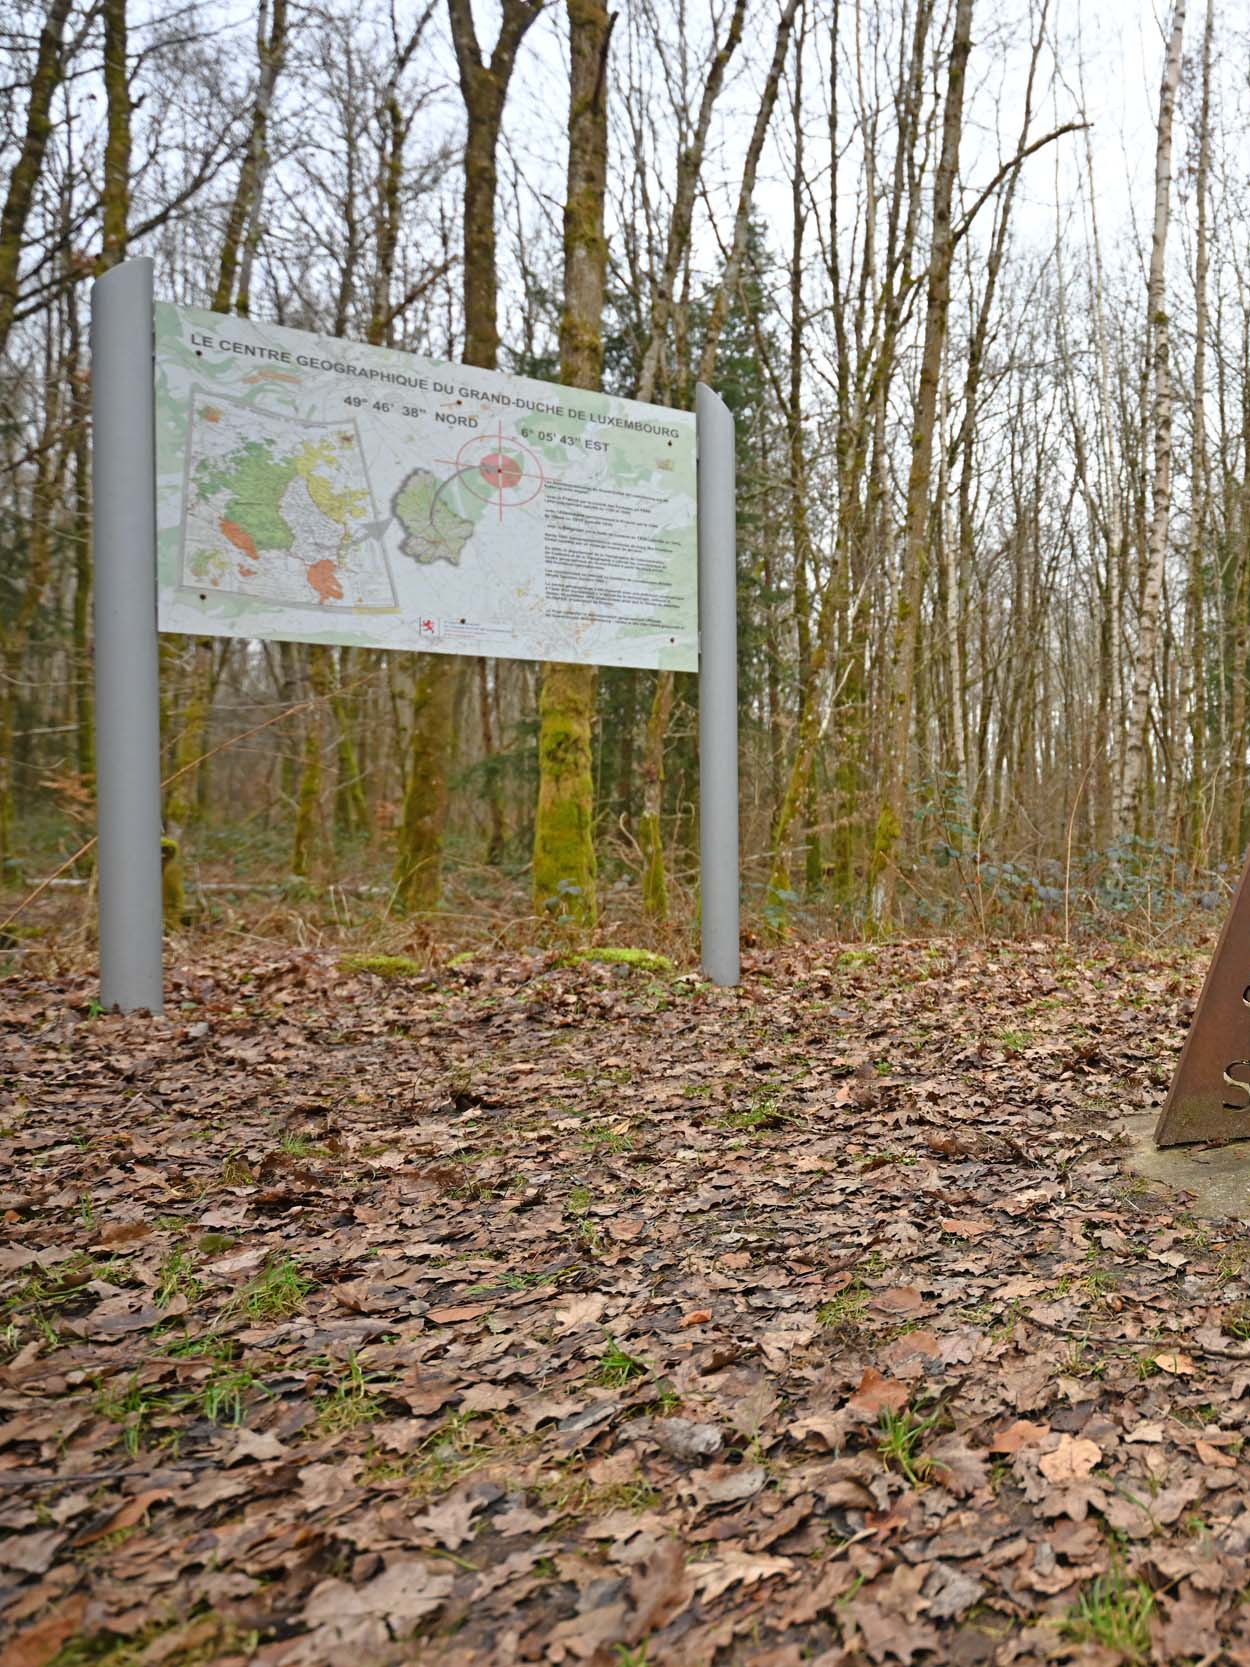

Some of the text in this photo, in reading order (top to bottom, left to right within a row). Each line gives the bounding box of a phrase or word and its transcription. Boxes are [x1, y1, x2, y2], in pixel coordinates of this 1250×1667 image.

[191, 333, 680, 439] LE CENTRE GEOGRAPHIQUE DU GRAND-DUCHE DE LUXEMBOURG
[434, 411, 479, 429] NORD
[584, 439, 610, 452] EST
